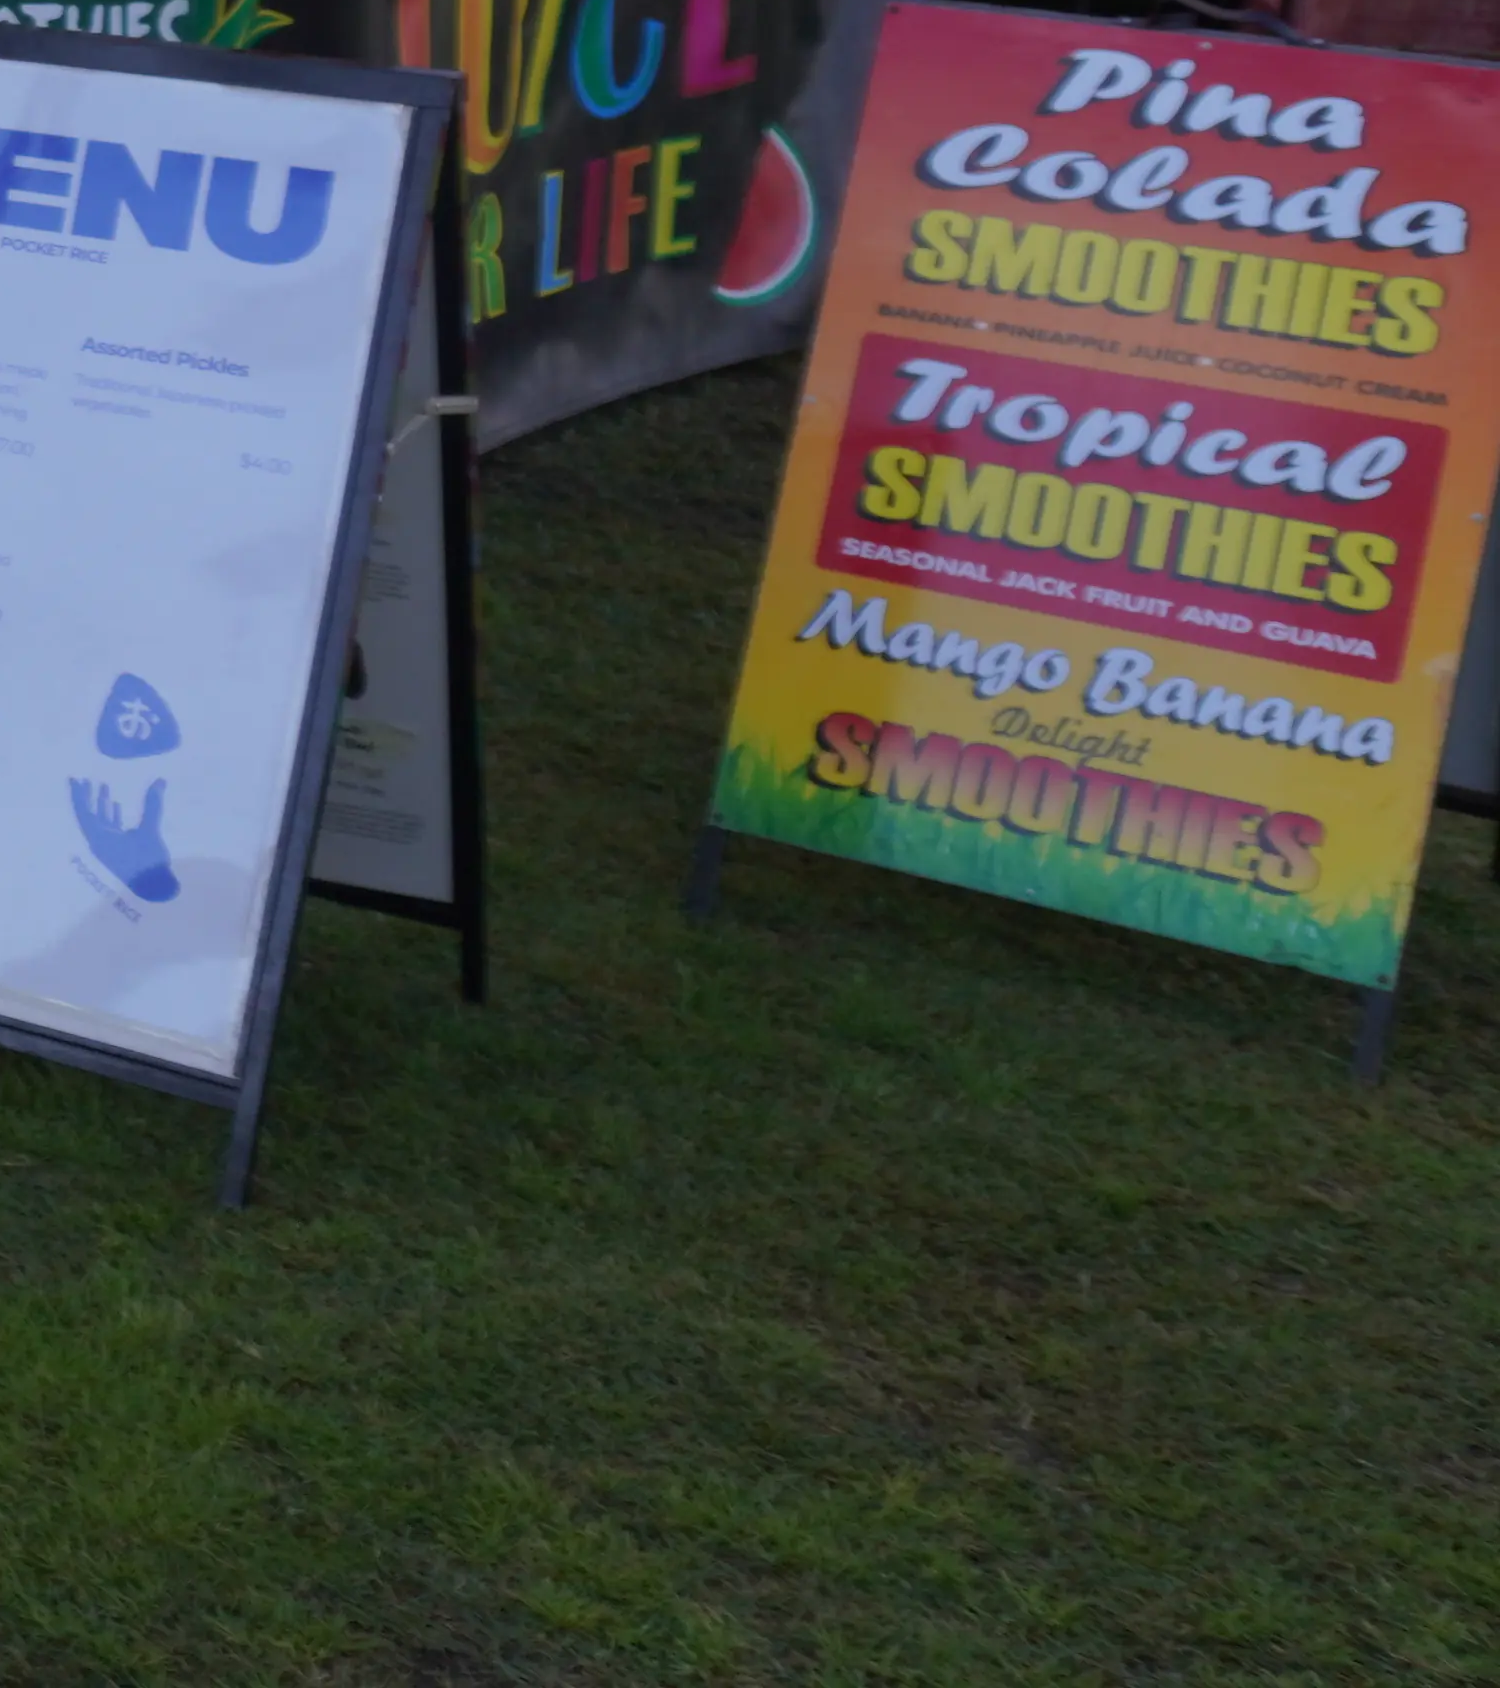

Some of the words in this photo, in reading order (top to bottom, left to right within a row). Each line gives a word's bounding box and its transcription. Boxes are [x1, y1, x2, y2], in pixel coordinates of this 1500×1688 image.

[1040, 49, 1365, 150] Pina
[1, 236, 68, 257] POCKET
[535, 136, 700, 297] LIFE
[918, 124, 1468, 255] Colada
[906, 209, 1444, 356] SMOOTHIES
[81, 336, 172, 365] Assorted
[994, 321, 1122, 354] PINEAPPLE
[1218, 357, 1348, 389] COCONUT
[1356, 380, 1449, 405] CREAM
[887, 359, 1406, 502] Tropical
[861, 446, 1398, 612] SMOOTHIES
[840, 537, 992, 583] SEASONAL
[999, 571, 1077, 599] JACK
[1083, 585, 1173, 618] FRUIT
[1177, 605, 1253, 633] AND
[1261, 621, 1377, 660] GUAVA
[117, 696, 161, 741] お
[800, 589, 1071, 700] Mango
[1085, 646, 1394, 764] Banana
[991, 706, 1151, 768] Delight
[811, 713, 1324, 895] SMOOTHIES
